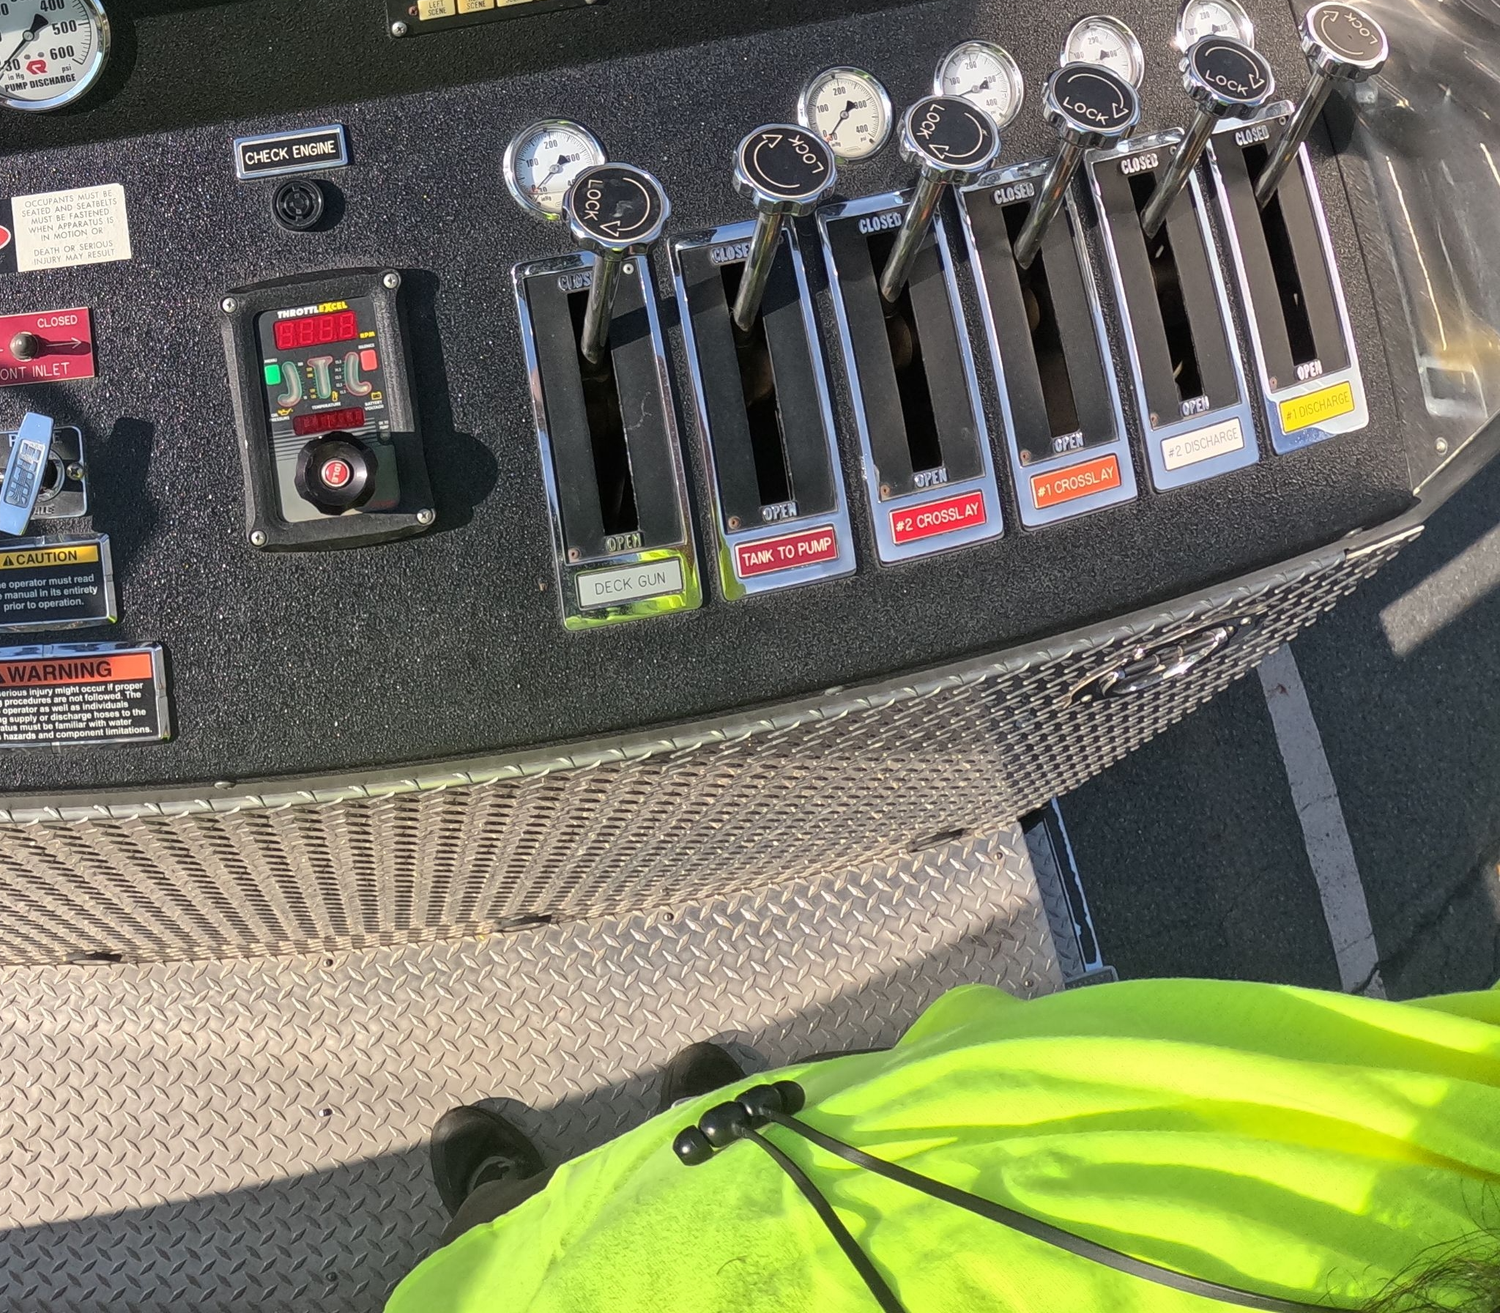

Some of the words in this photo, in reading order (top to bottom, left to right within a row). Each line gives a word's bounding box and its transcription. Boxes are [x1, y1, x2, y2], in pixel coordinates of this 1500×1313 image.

[428, 0, 444, 9] LEFT
[428, 8, 446, 16] SCENE
[467, 0, 486, 10] SCENE
[62, 64, 72, 73] psi
[5, 82, 28, 92] PUMP
[30, 73, 76, 88] DISCHARGE
[1205, 70, 1249, 97] LOCK
[1063, 96, 1109, 125] LOCK
[245, 147, 289, 165] CHECK
[292, 140, 336, 159] ENGINE
[25, 195, 75, 208] OCCUPANTS
[77, 192, 100, 200] MUST
[103, 190, 112, 198] BE
[22, 207, 51, 218] SEATED
[55, 204, 73, 213] AND
[77, 198, 118, 210] SEATBELTS
[31, 216, 52, 225] MUST
[56, 213, 66, 222] BE
[69, 208, 110, 220] FASTENED
[28, 224, 54, 234] WHEN
[57, 218, 104, 231] APPARATUS
[106, 217, 114, 225] IS
[41, 233, 50, 241] IN
[54, 229, 87, 240] MOTION
[91, 227, 104, 235] OR
[34, 246, 60, 257] DEATH
[64, 244, 76, 253] OR
[79, 240, 113, 251] SERIOUS
[34, 255, 61, 266] INJURY
[65, 252, 84, 262] MAY
[88, 249, 115, 259] RESULT
[37, 315, 78, 328] CLOSED
[360, 331, 375, 339] RPM
[32, 362, 70, 378] INLET
[1287, 409, 1298, 421] #1
[1299, 391, 1350, 417] DISCHARGE
[1168, 444, 1182, 458] #2
[1184, 427, 1239, 454] DISCHARGE
[331, 463, 342, 483] IDLE
[1037, 483, 1052, 497] #1
[1054, 466, 1115, 495] CROSSLAY
[896, 519, 913, 532] #2
[916, 502, 979, 529] CROSSLAY
[16, 550, 78, 565] CAUTION
[742, 549, 775, 567] TANK
[779, 543, 795, 559] TO
[797, 537, 832, 556] PUMP
[9, 579, 47, 589] operator
[49, 576, 72, 585] must
[74, 574, 94, 583] read
[594, 574, 632, 596] DECK
[638, 572, 666, 587] GUN
[4, 590, 38, 599] manual
[40, 589, 48, 597] in
[50, 588, 61, 596] its
[64, 585, 98, 596] entirety
[3, 601, 24, 612] prior
[27, 601, 36, 609] to
[38, 598, 84, 609] operation.
[7, 661, 112, 683] WARNING
[29, 687, 52, 697] injury
[55, 686, 79, 695] might
[82, 685, 105, 693] occur
[107, 683, 113, 691] if
[115, 682, 144, 691] proper
[4, 697, 51, 706] procedures
[53, 695, 67, 703] are
[69, 694, 83, 702] not
[84, 692, 123, 701] followed.
[125, 691, 141, 699] The
[3, 705, 37, 715] operator
[40, 705, 49, 713] as
[83, 701, 128, 709] individuals
[9, 714, 37, 724] supply
[50, 711, 92, 721] discharge
[94, 709, 120, 718] hoses
[122, 709, 130, 717] to
[132, 708, 146, 716] the
[20, 722, 41, 731] must
[43, 721, 53, 730] be
[55, 720, 87, 729] familiar
[89, 719, 106, 727] with
[109, 717, 132, 726] water
[4, 731, 36, 741] hazards
[38, 730, 54, 739] and
[56, 729, 103, 739] component
[105, 725, 153, 736] limitations.
